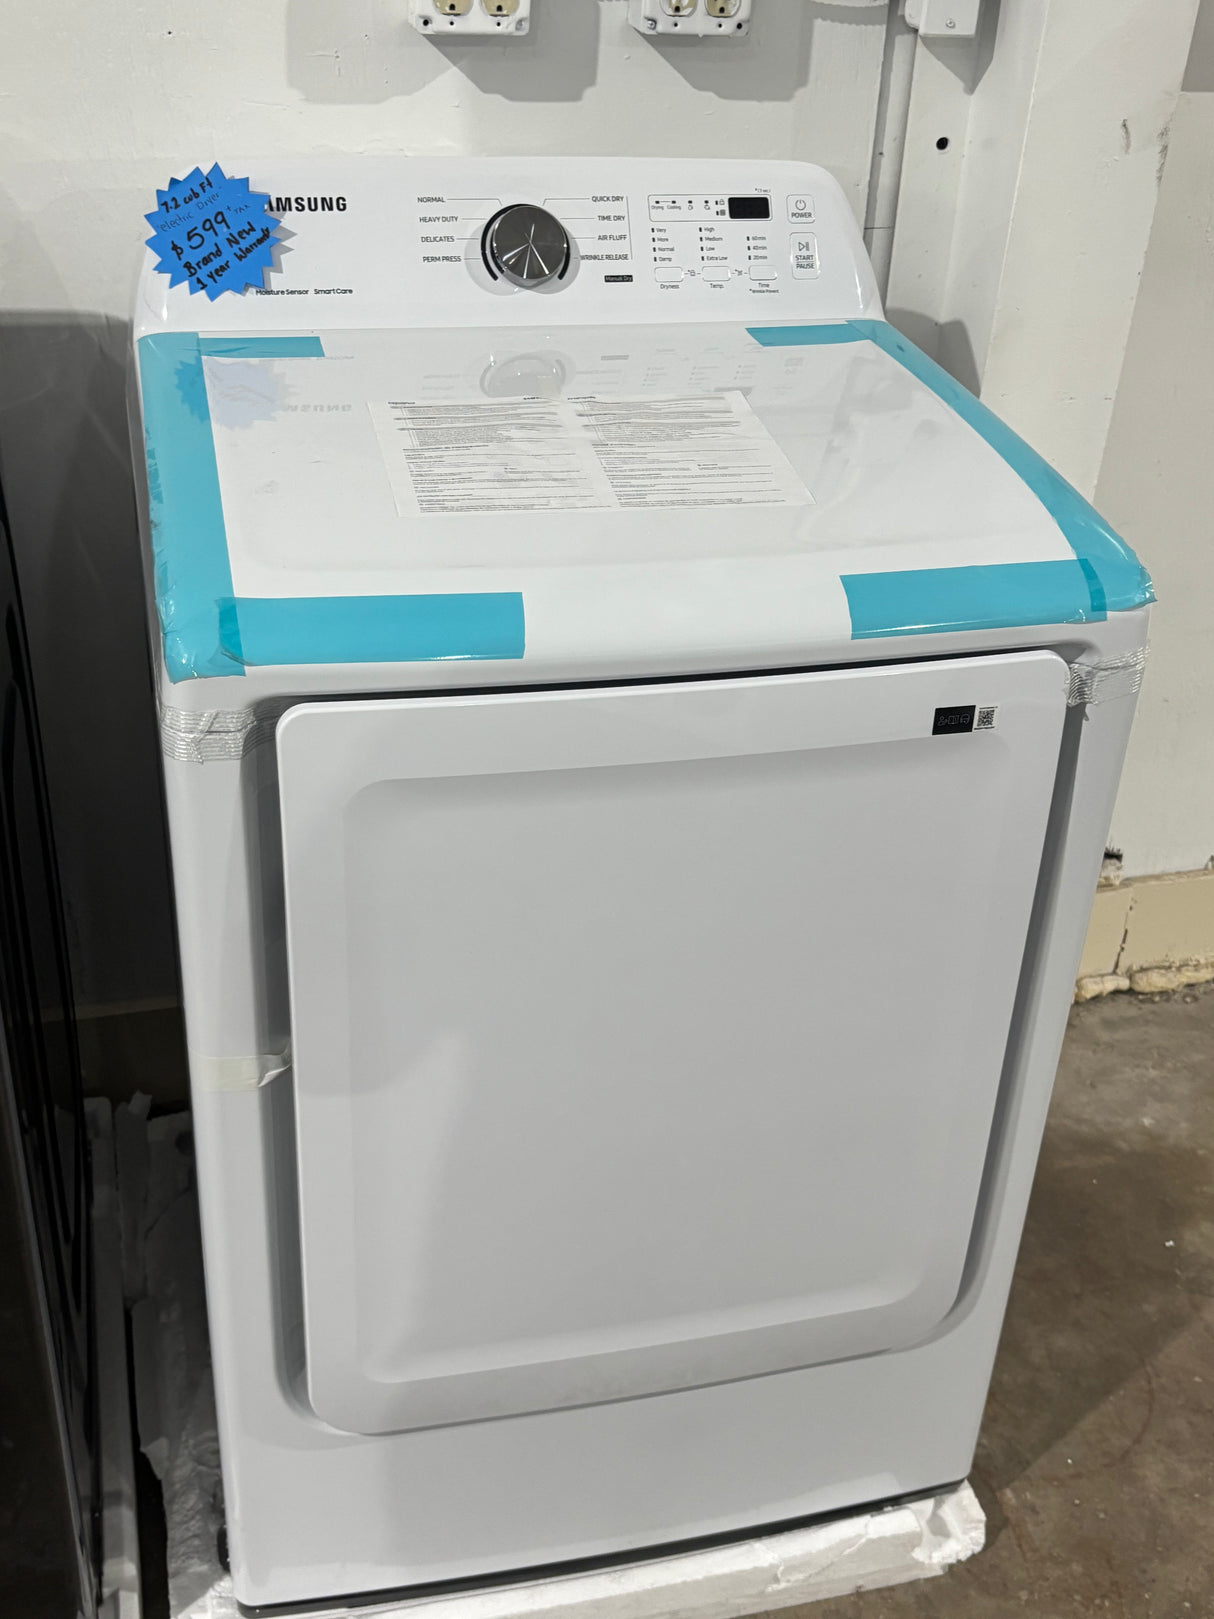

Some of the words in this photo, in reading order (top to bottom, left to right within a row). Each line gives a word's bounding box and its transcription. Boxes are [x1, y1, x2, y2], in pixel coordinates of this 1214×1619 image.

[160, 196, 181, 213] 7.2
[264, 196, 347, 212] AMSUNG
[420, 235, 455, 243] DELICATES
[183, 242, 223, 277] Brand
[225, 221, 257, 249] New
[422, 255, 441, 263] PERM
[195, 277, 208, 290] 1
[255, 288, 285, 296] Moisture
